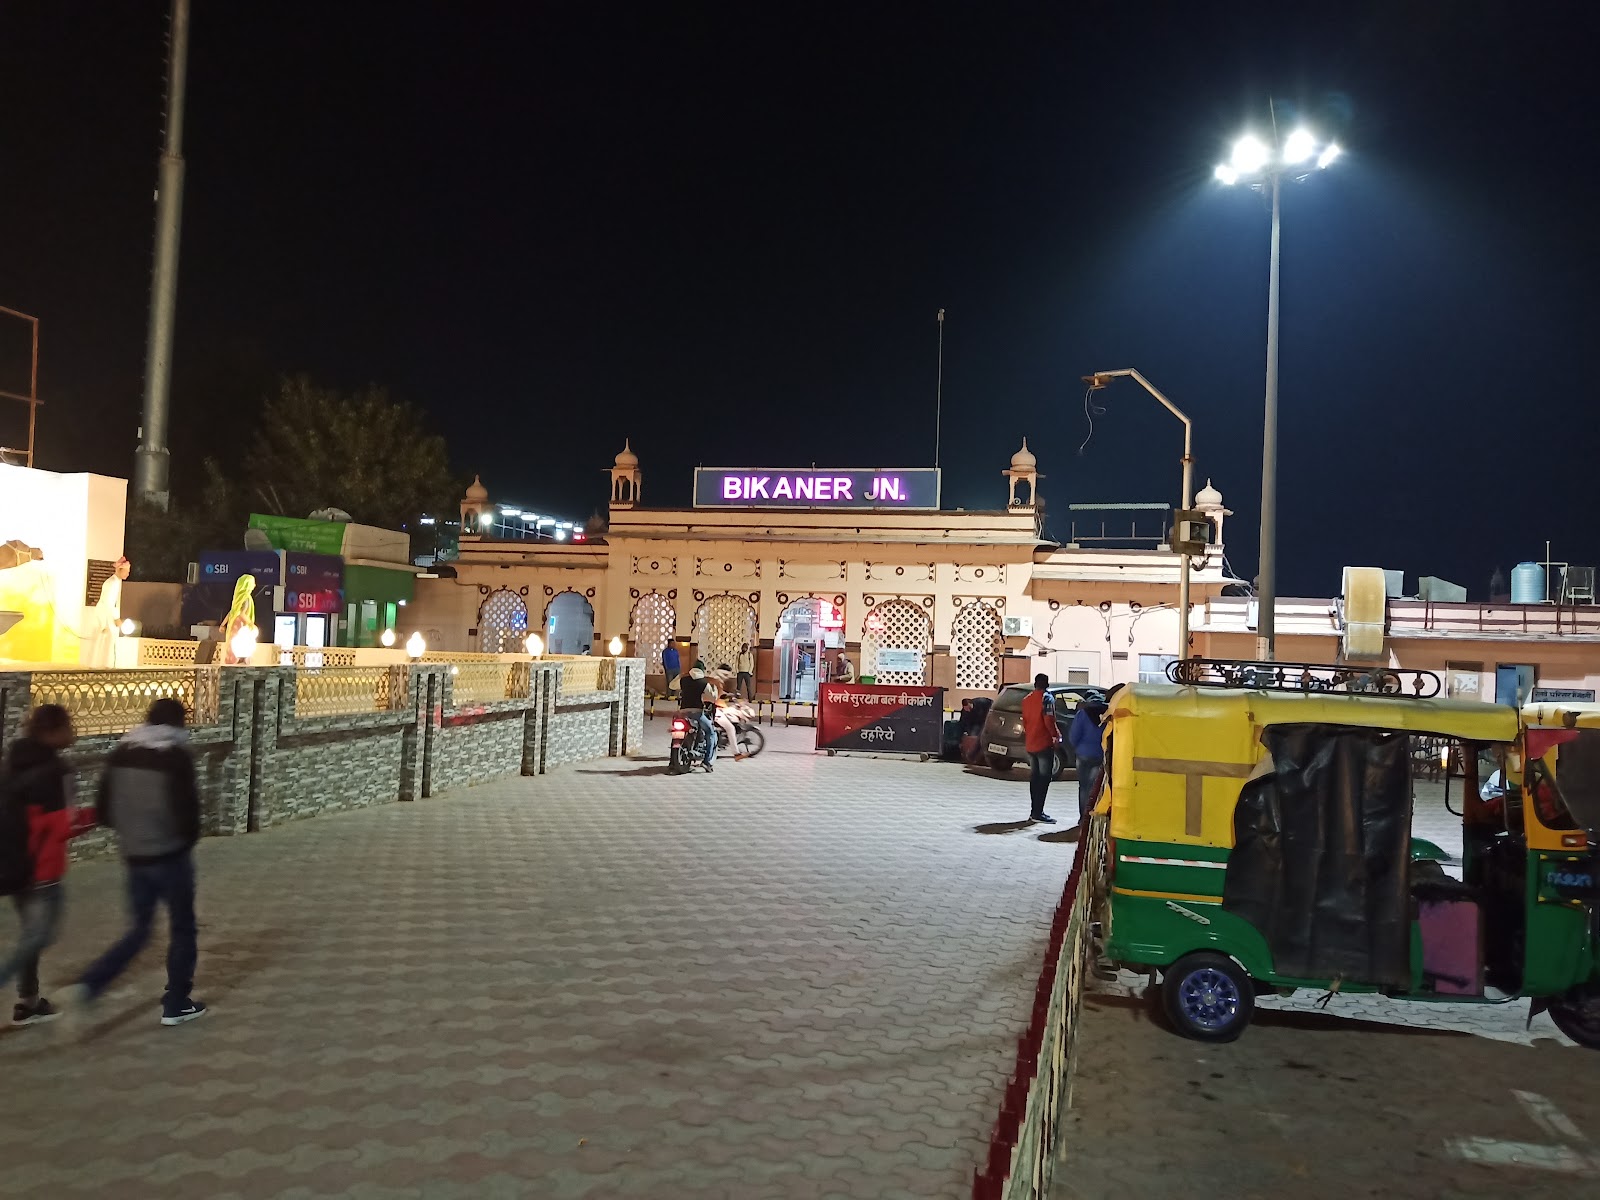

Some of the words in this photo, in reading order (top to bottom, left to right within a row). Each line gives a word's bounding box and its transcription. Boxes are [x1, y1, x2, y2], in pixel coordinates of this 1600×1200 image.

[723, 476, 853, 500] BIKANER
[864, 477, 906, 500] JN.
[290, 540, 316, 549] ATM
[214, 564, 228, 574] SBI
[296, 565, 307, 575] SBI
[298, 592, 316, 608] SBI
[827, 690, 848, 704] रेलवे
[850, 693, 879, 707] सुरक्षा
[880, 694, 897, 705] बल
[898, 692, 933, 707] बीकानेर
[860, 726, 895, 741] ठहरिये
